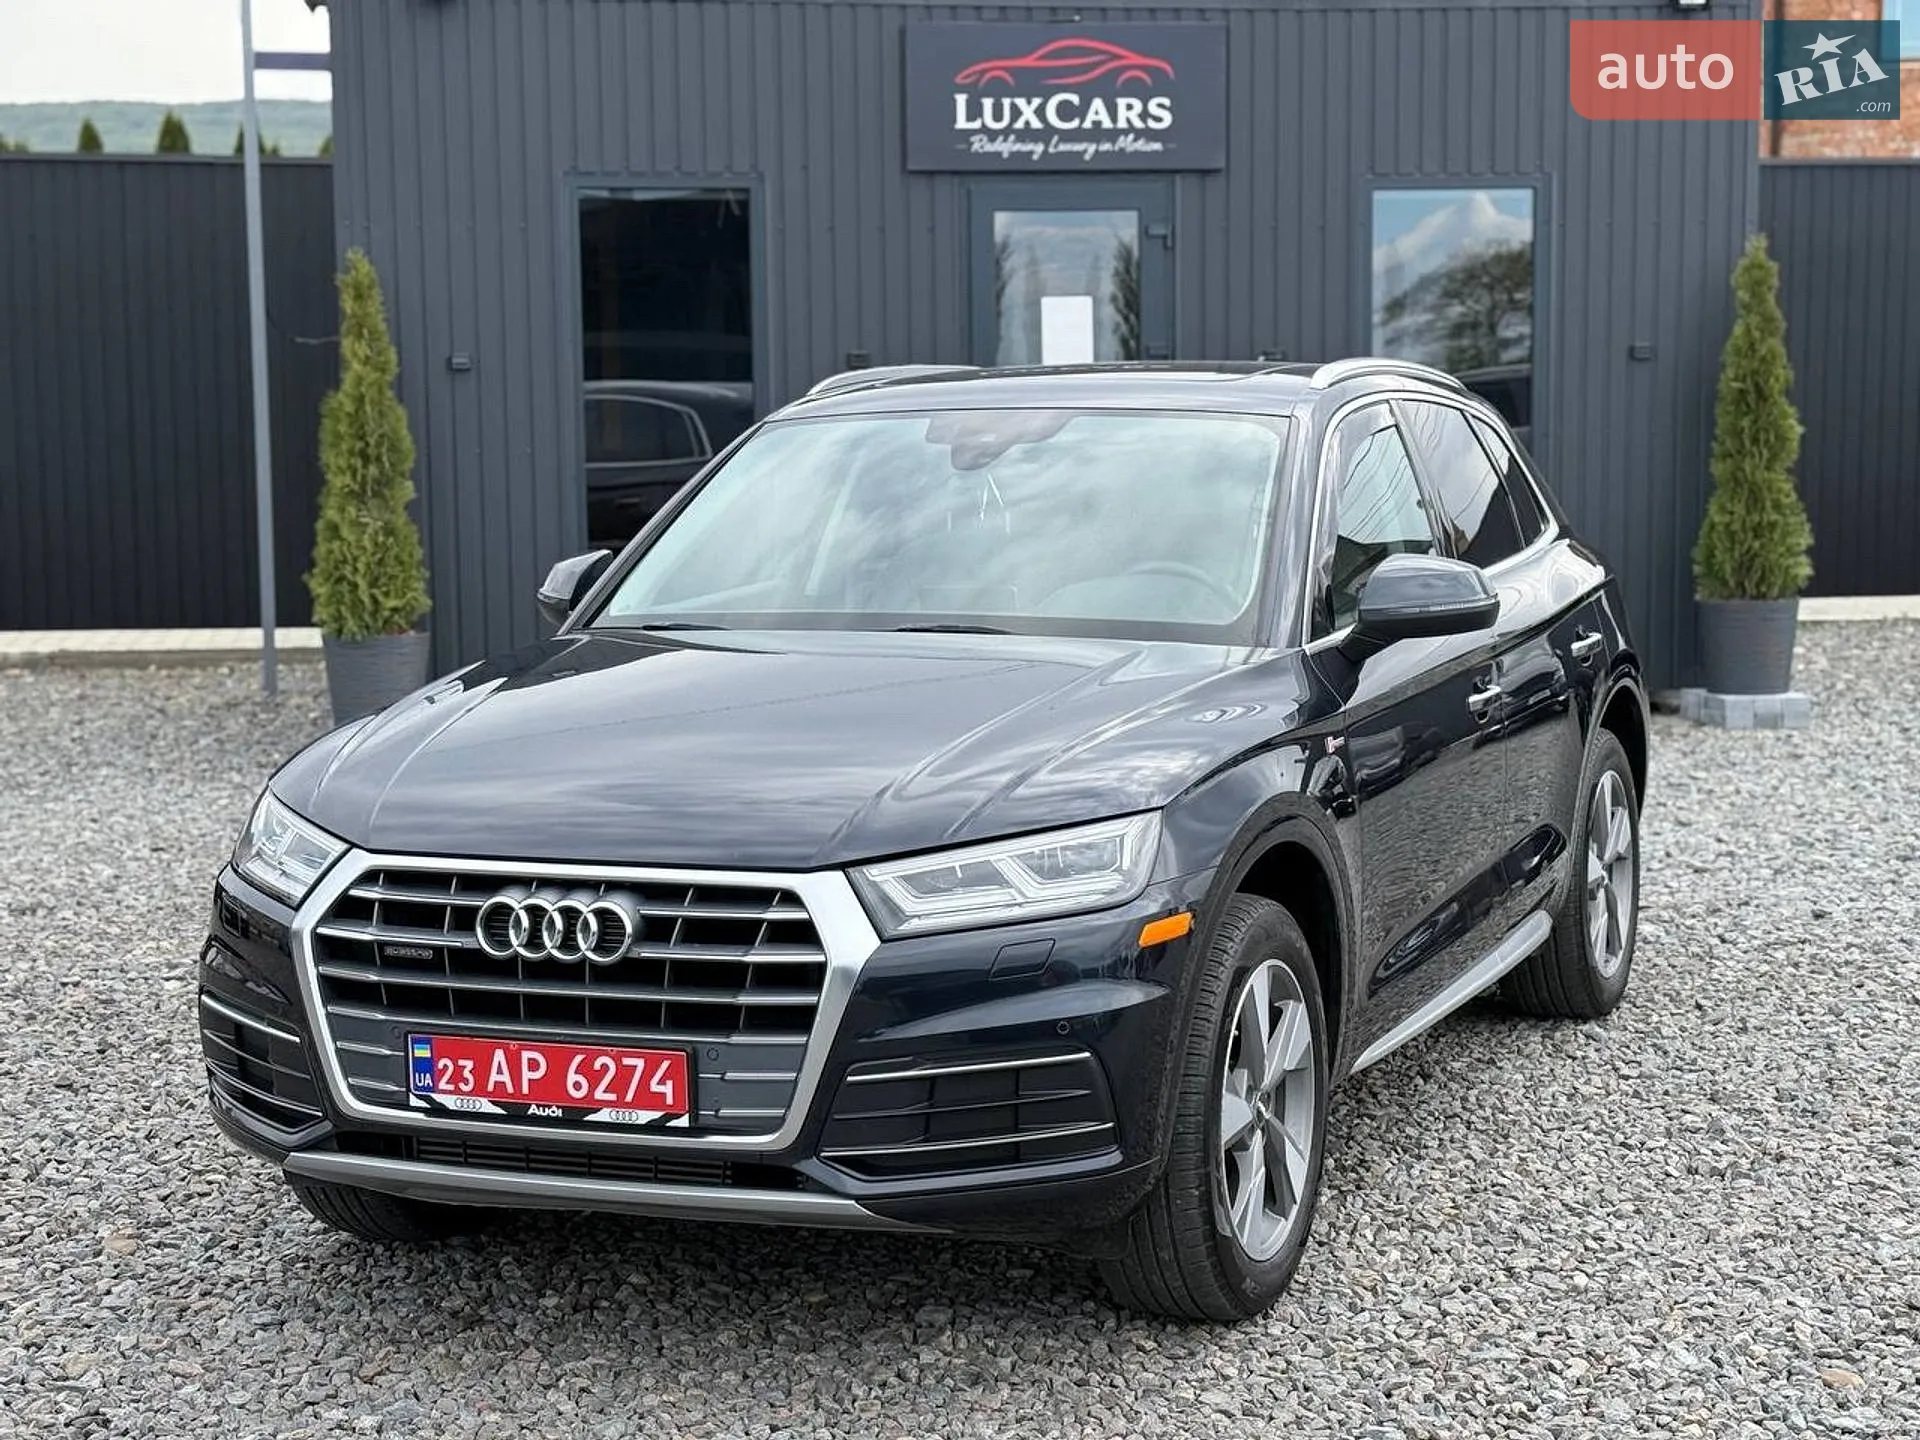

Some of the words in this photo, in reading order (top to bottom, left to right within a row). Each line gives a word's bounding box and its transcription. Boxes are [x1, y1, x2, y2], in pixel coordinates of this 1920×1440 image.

[969, 134, 1045, 161] Redefining
[1048, 134, 1097, 161] Luxury
[1115, 132, 1164, 153] Motion
[415, 1072, 433, 1088] UA
[436, 1057, 475, 1092] 23
[487, 1048, 548, 1095] AP
[566, 1053, 674, 1106] 6274
[527, 1104, 563, 1118] Audi
